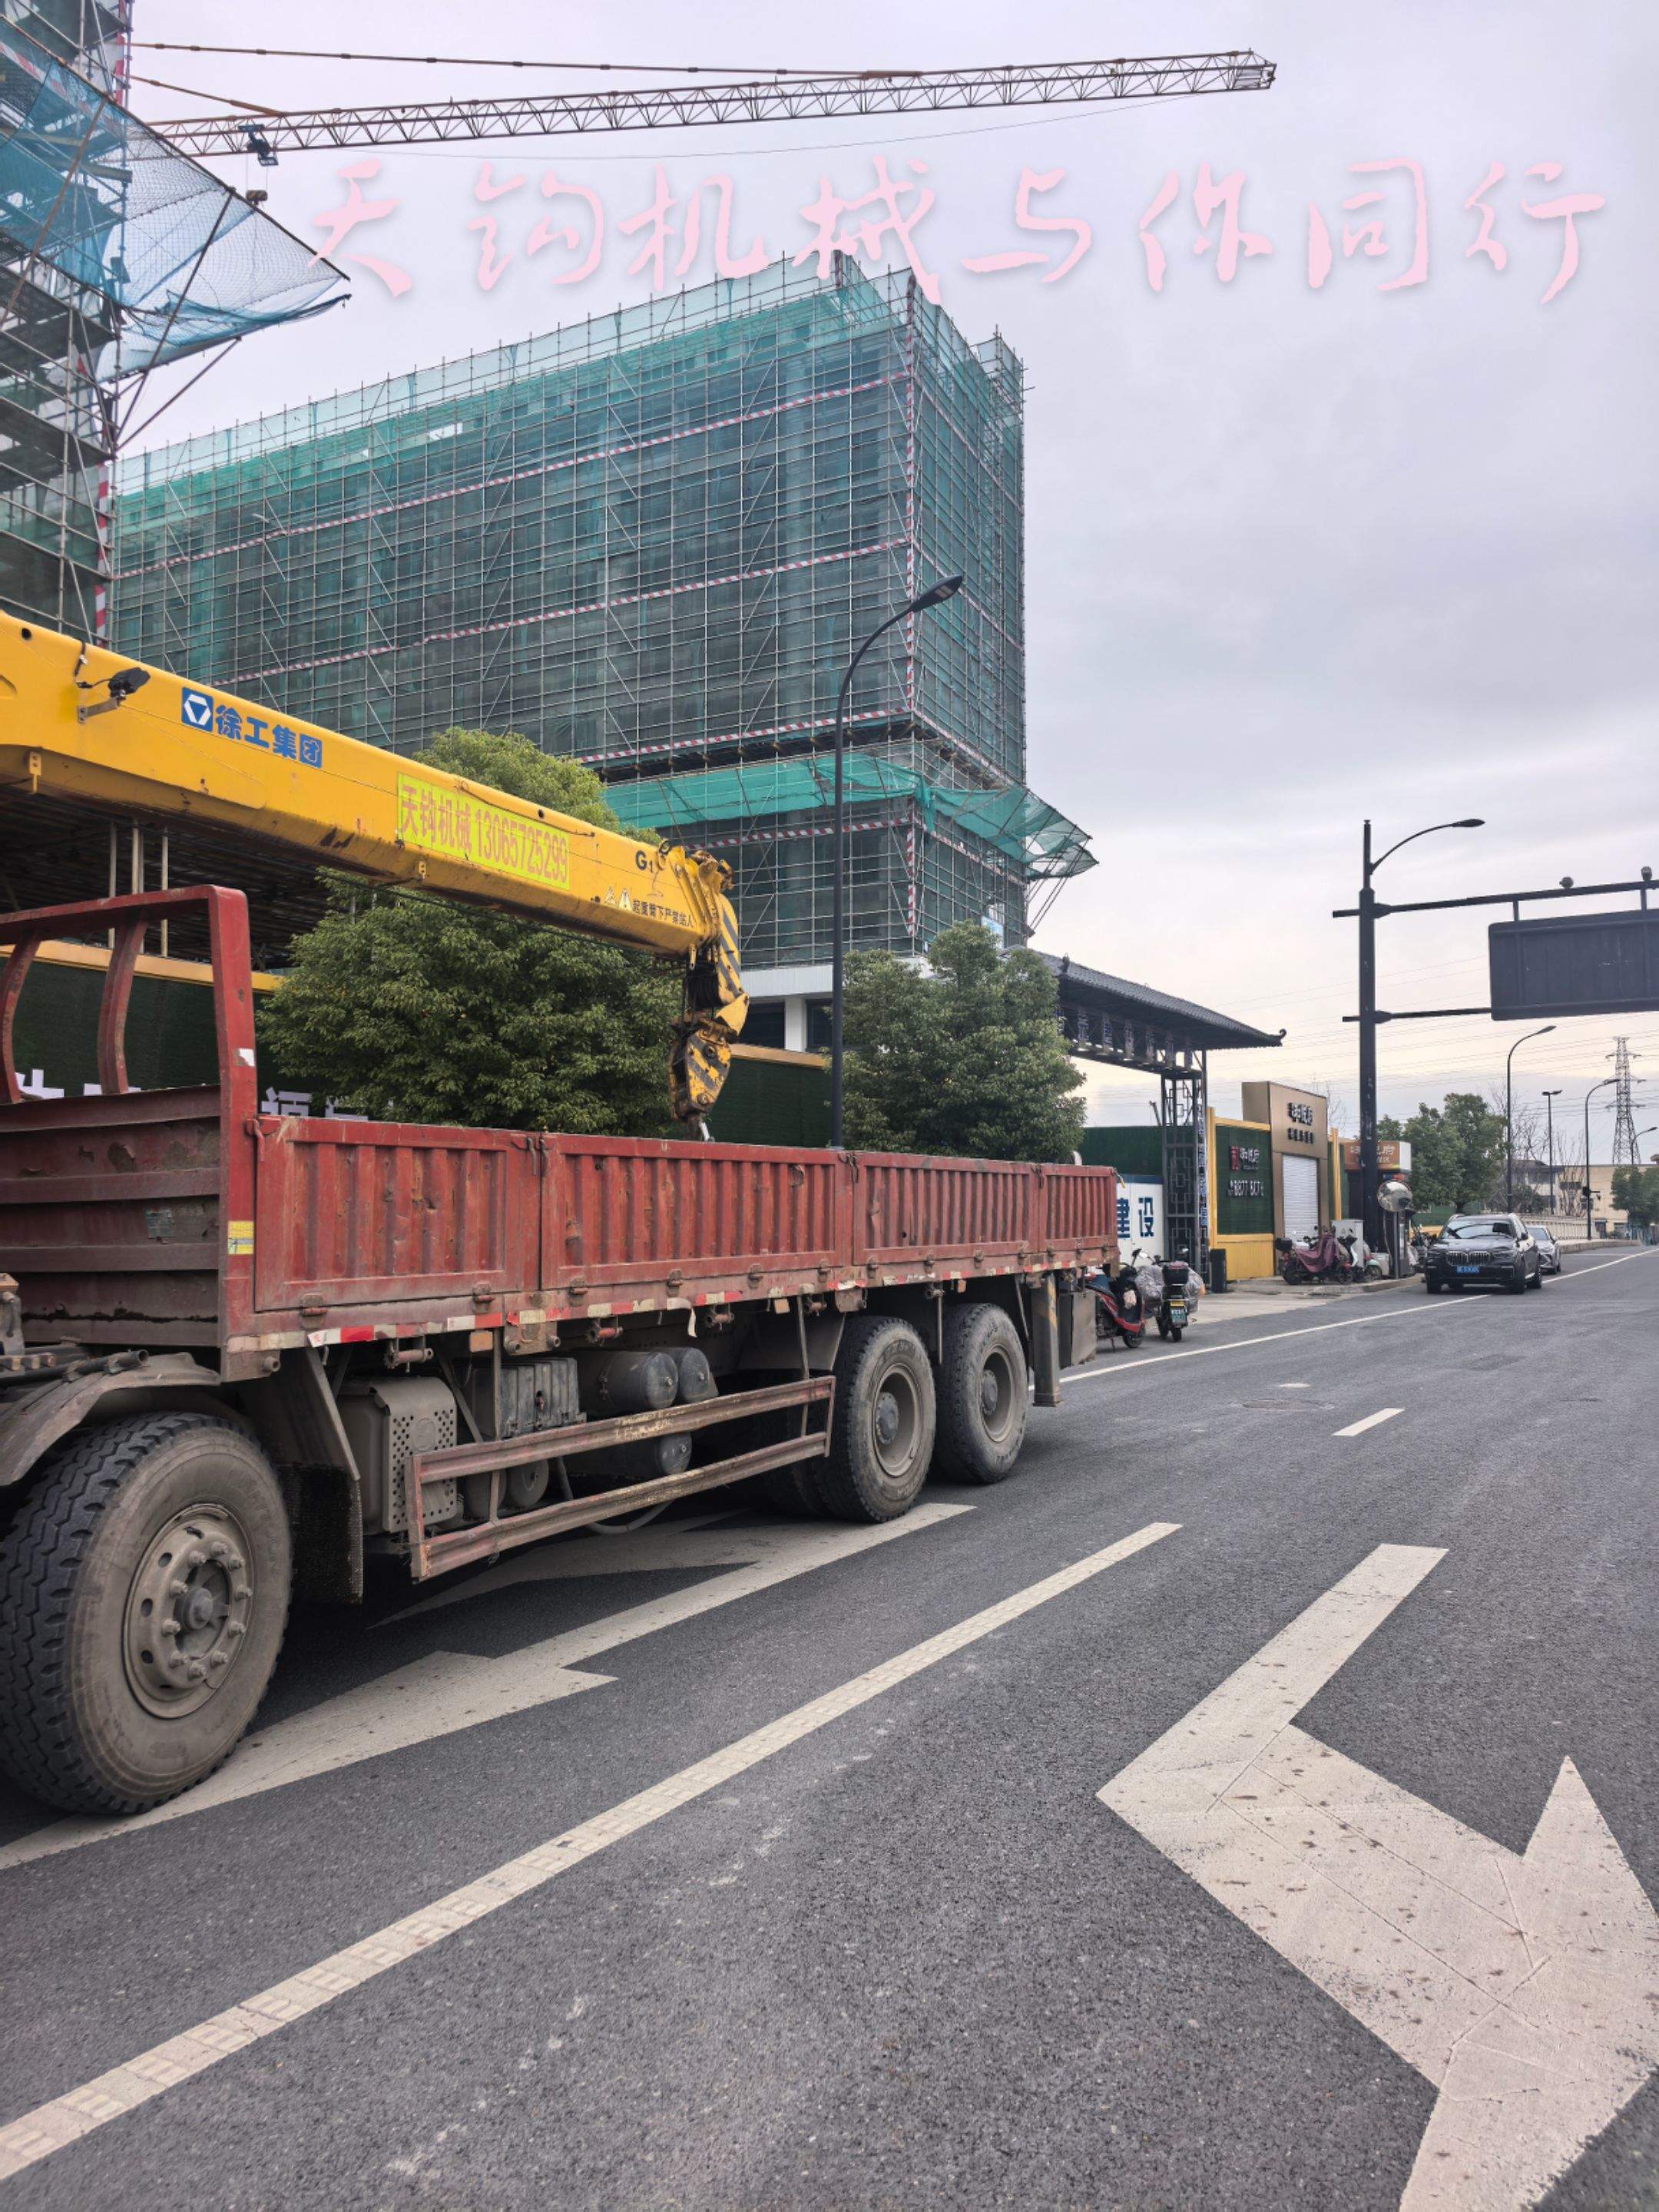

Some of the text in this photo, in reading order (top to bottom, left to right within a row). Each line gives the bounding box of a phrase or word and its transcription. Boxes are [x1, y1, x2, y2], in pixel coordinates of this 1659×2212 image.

[216, 704, 323, 769] 徐工集团
[401, 784, 568, 883] 天钩机械 13065725299
